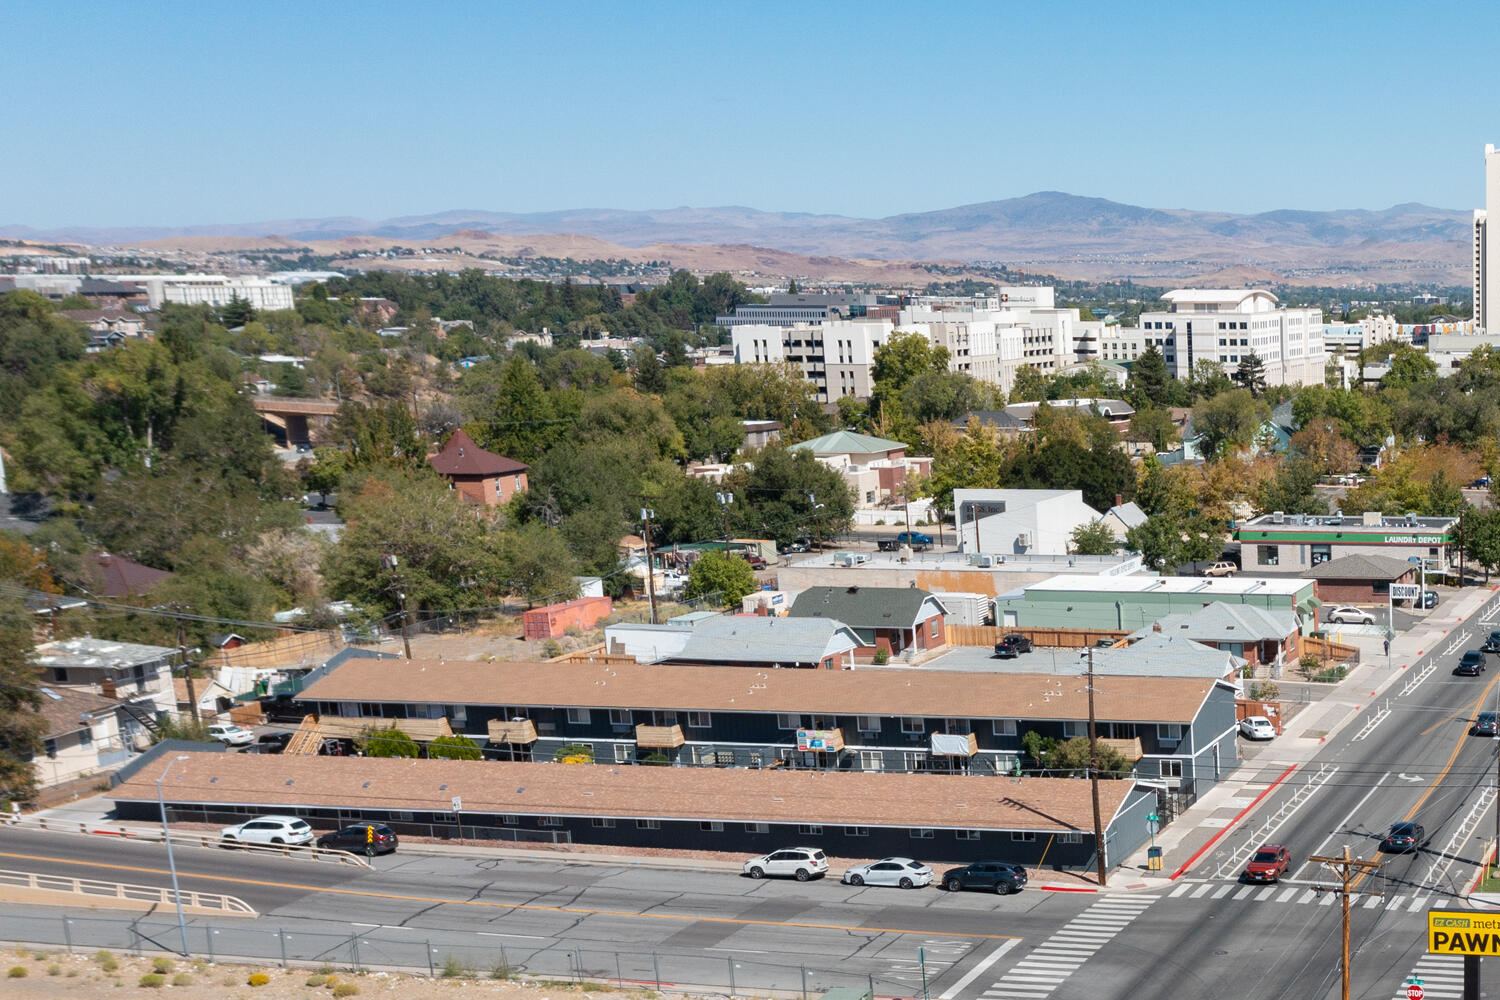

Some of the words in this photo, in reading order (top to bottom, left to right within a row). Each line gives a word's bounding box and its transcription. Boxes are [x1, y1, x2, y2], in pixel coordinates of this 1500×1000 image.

[1418, 536, 1442, 544] DEPOT
[1392, 586, 1418, 597] DISCOUNT
[1434, 918, 1445, 927] EZ
[1445, 919, 1470, 928] CASH
[1407, 989, 1423, 997] STOP
